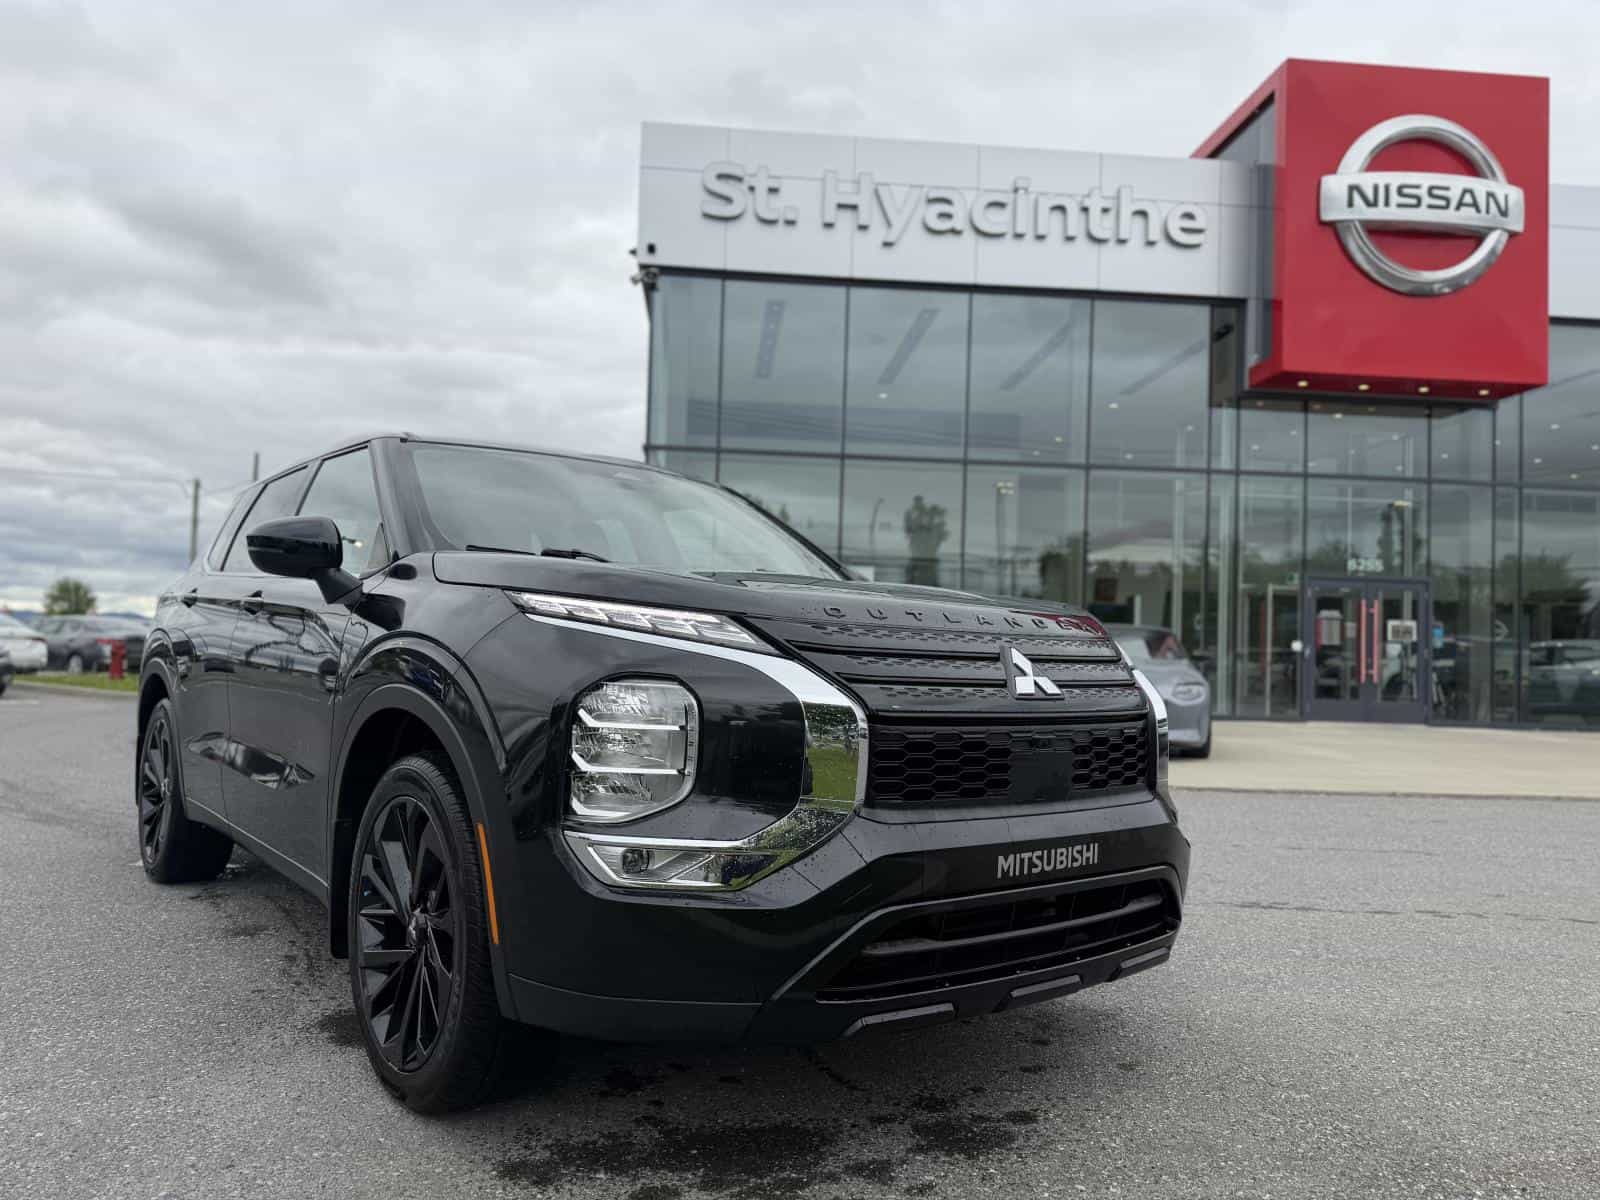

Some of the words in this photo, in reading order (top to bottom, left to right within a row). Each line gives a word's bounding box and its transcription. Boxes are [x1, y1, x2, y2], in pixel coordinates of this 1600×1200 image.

[702, 161, 798, 225] St.
[822, 169, 1207, 247] Hyacinthe
[1347, 183, 1510, 218] NISSAN
[997, 842, 1099, 879] MITSUBISHI
